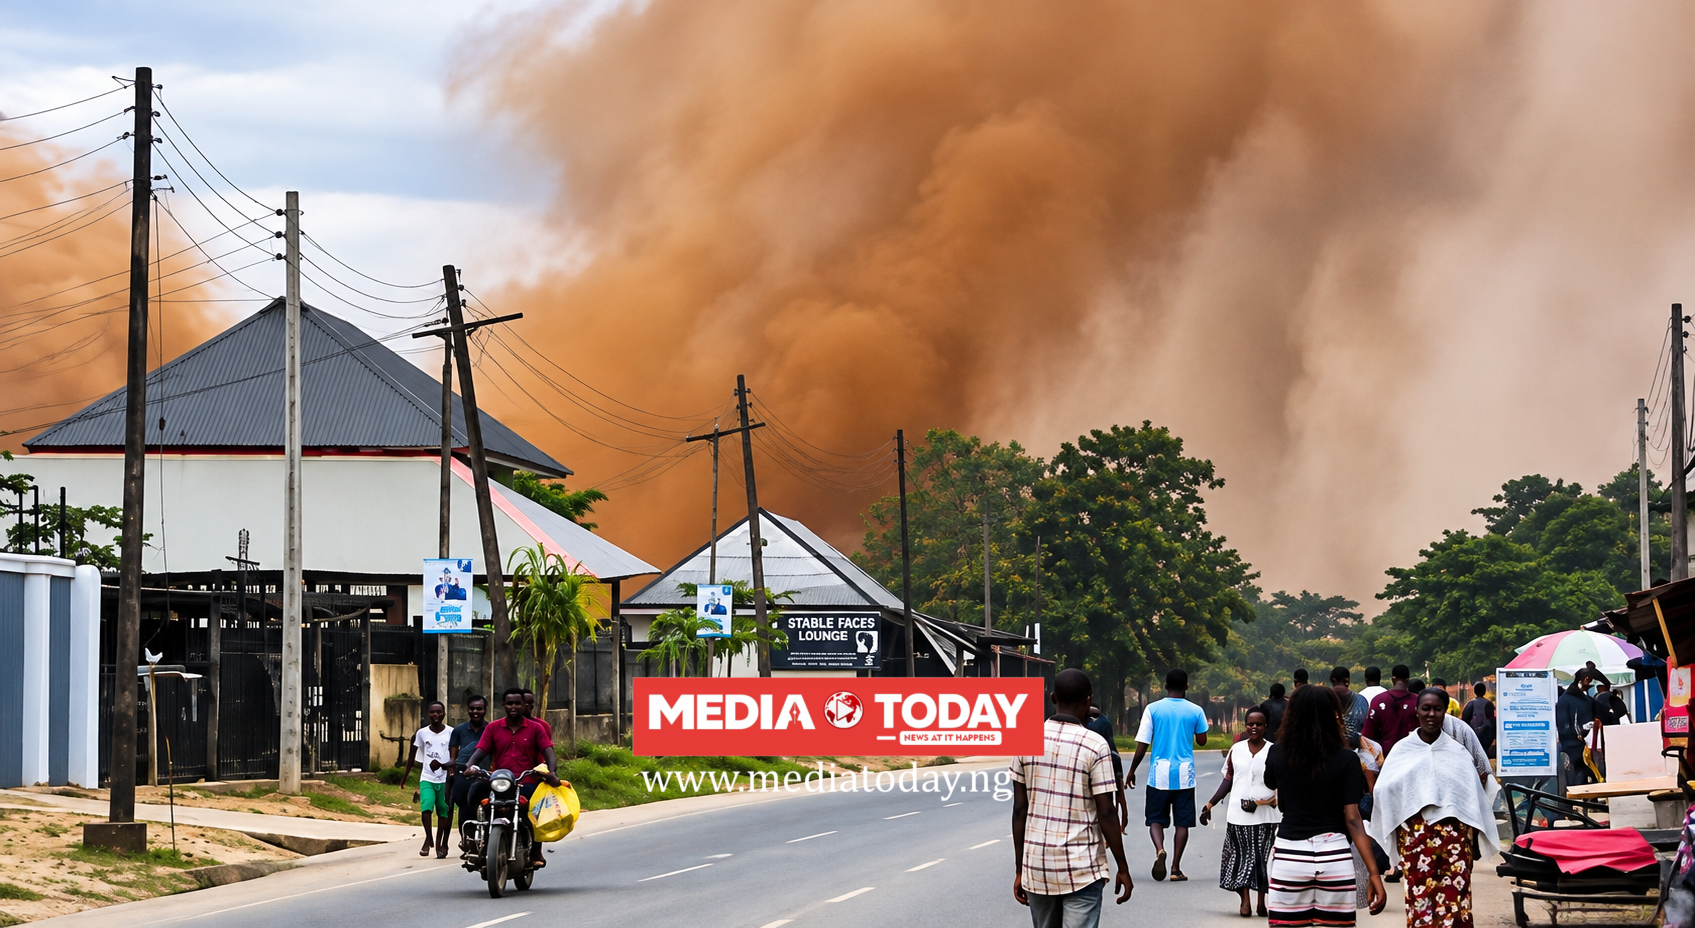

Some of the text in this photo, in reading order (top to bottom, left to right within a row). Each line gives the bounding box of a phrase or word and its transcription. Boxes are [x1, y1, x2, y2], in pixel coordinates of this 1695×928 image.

[788, 617, 875, 628] STABLE FACES
[799, 630, 848, 641] LOUNGE
